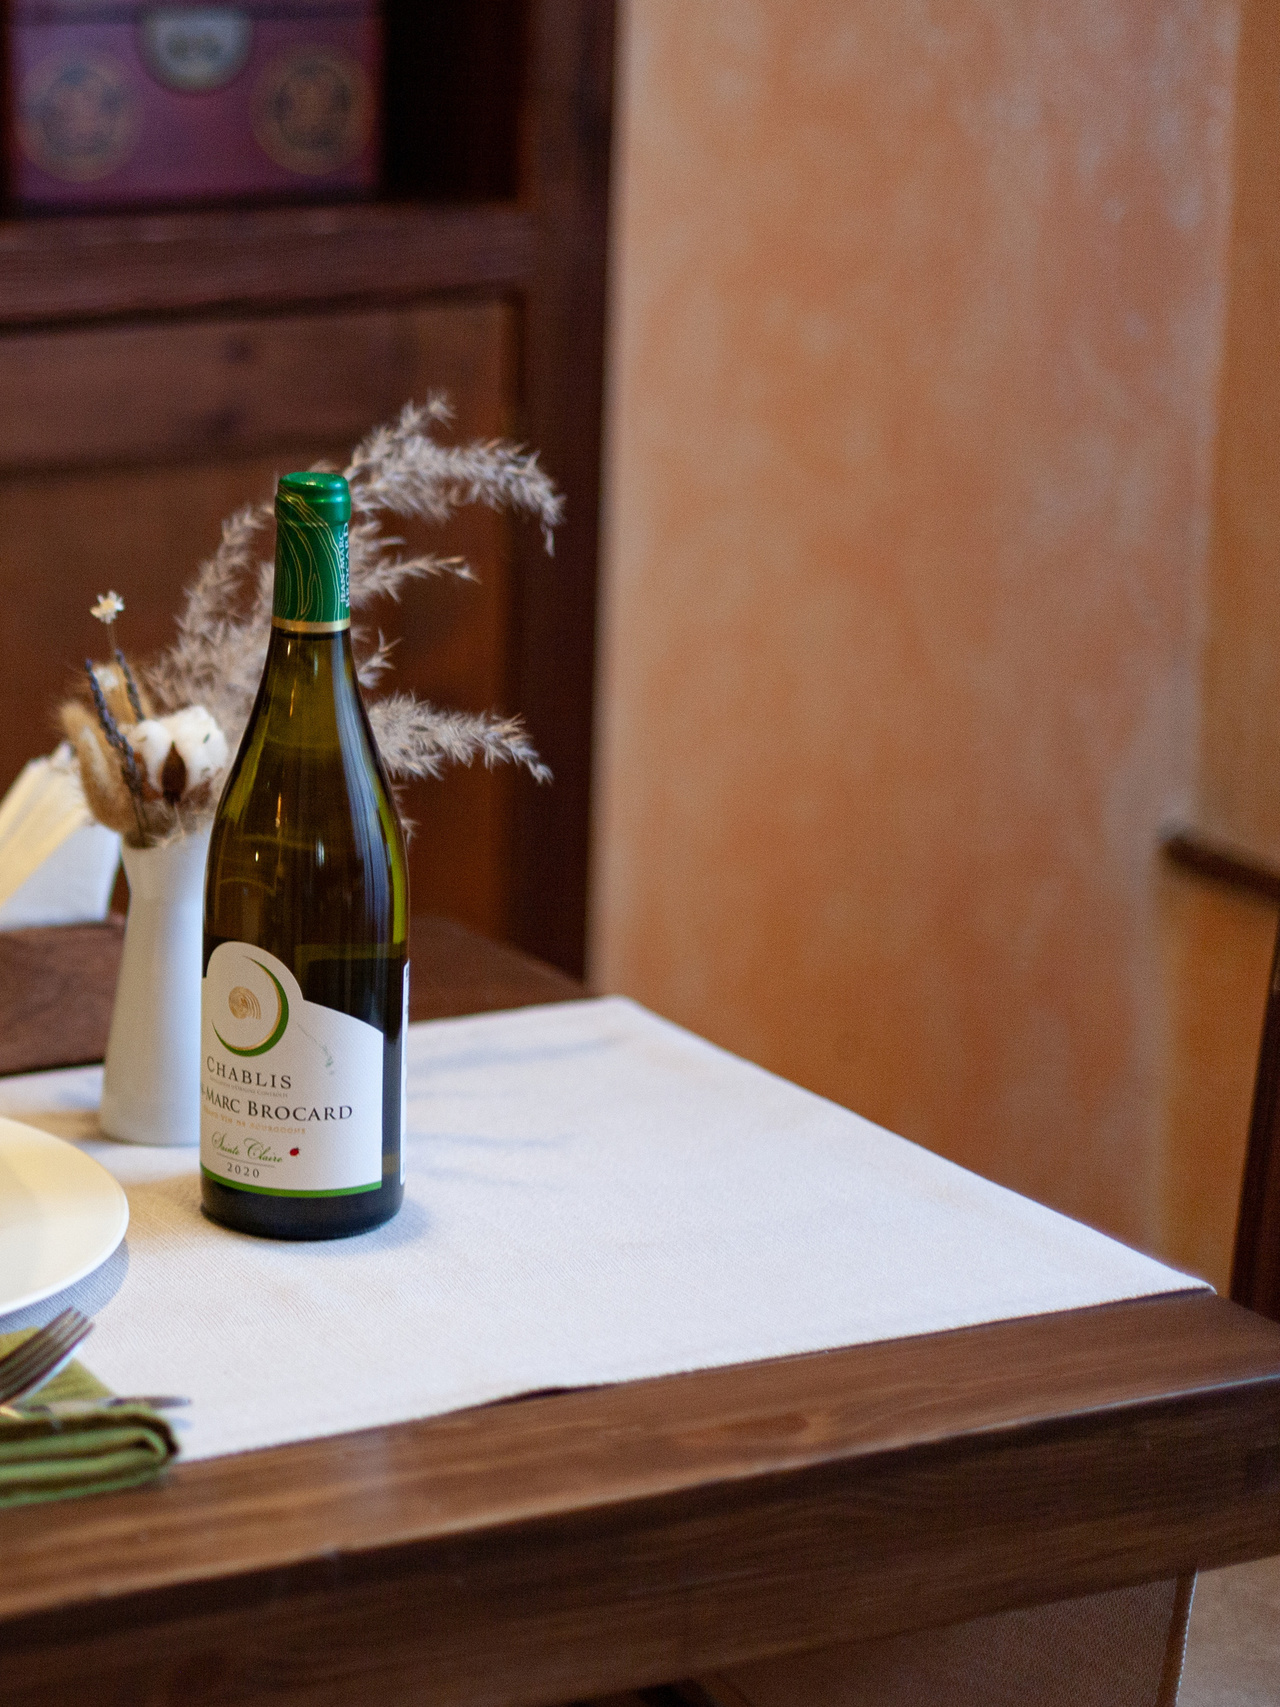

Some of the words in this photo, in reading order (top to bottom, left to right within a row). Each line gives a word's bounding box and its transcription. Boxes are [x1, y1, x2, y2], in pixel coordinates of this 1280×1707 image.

[207, 1056, 291, 1090] CHABLIS
[248, 1100, 353, 1121] BROCARD
[227, 1162, 260, 1179] 2020
